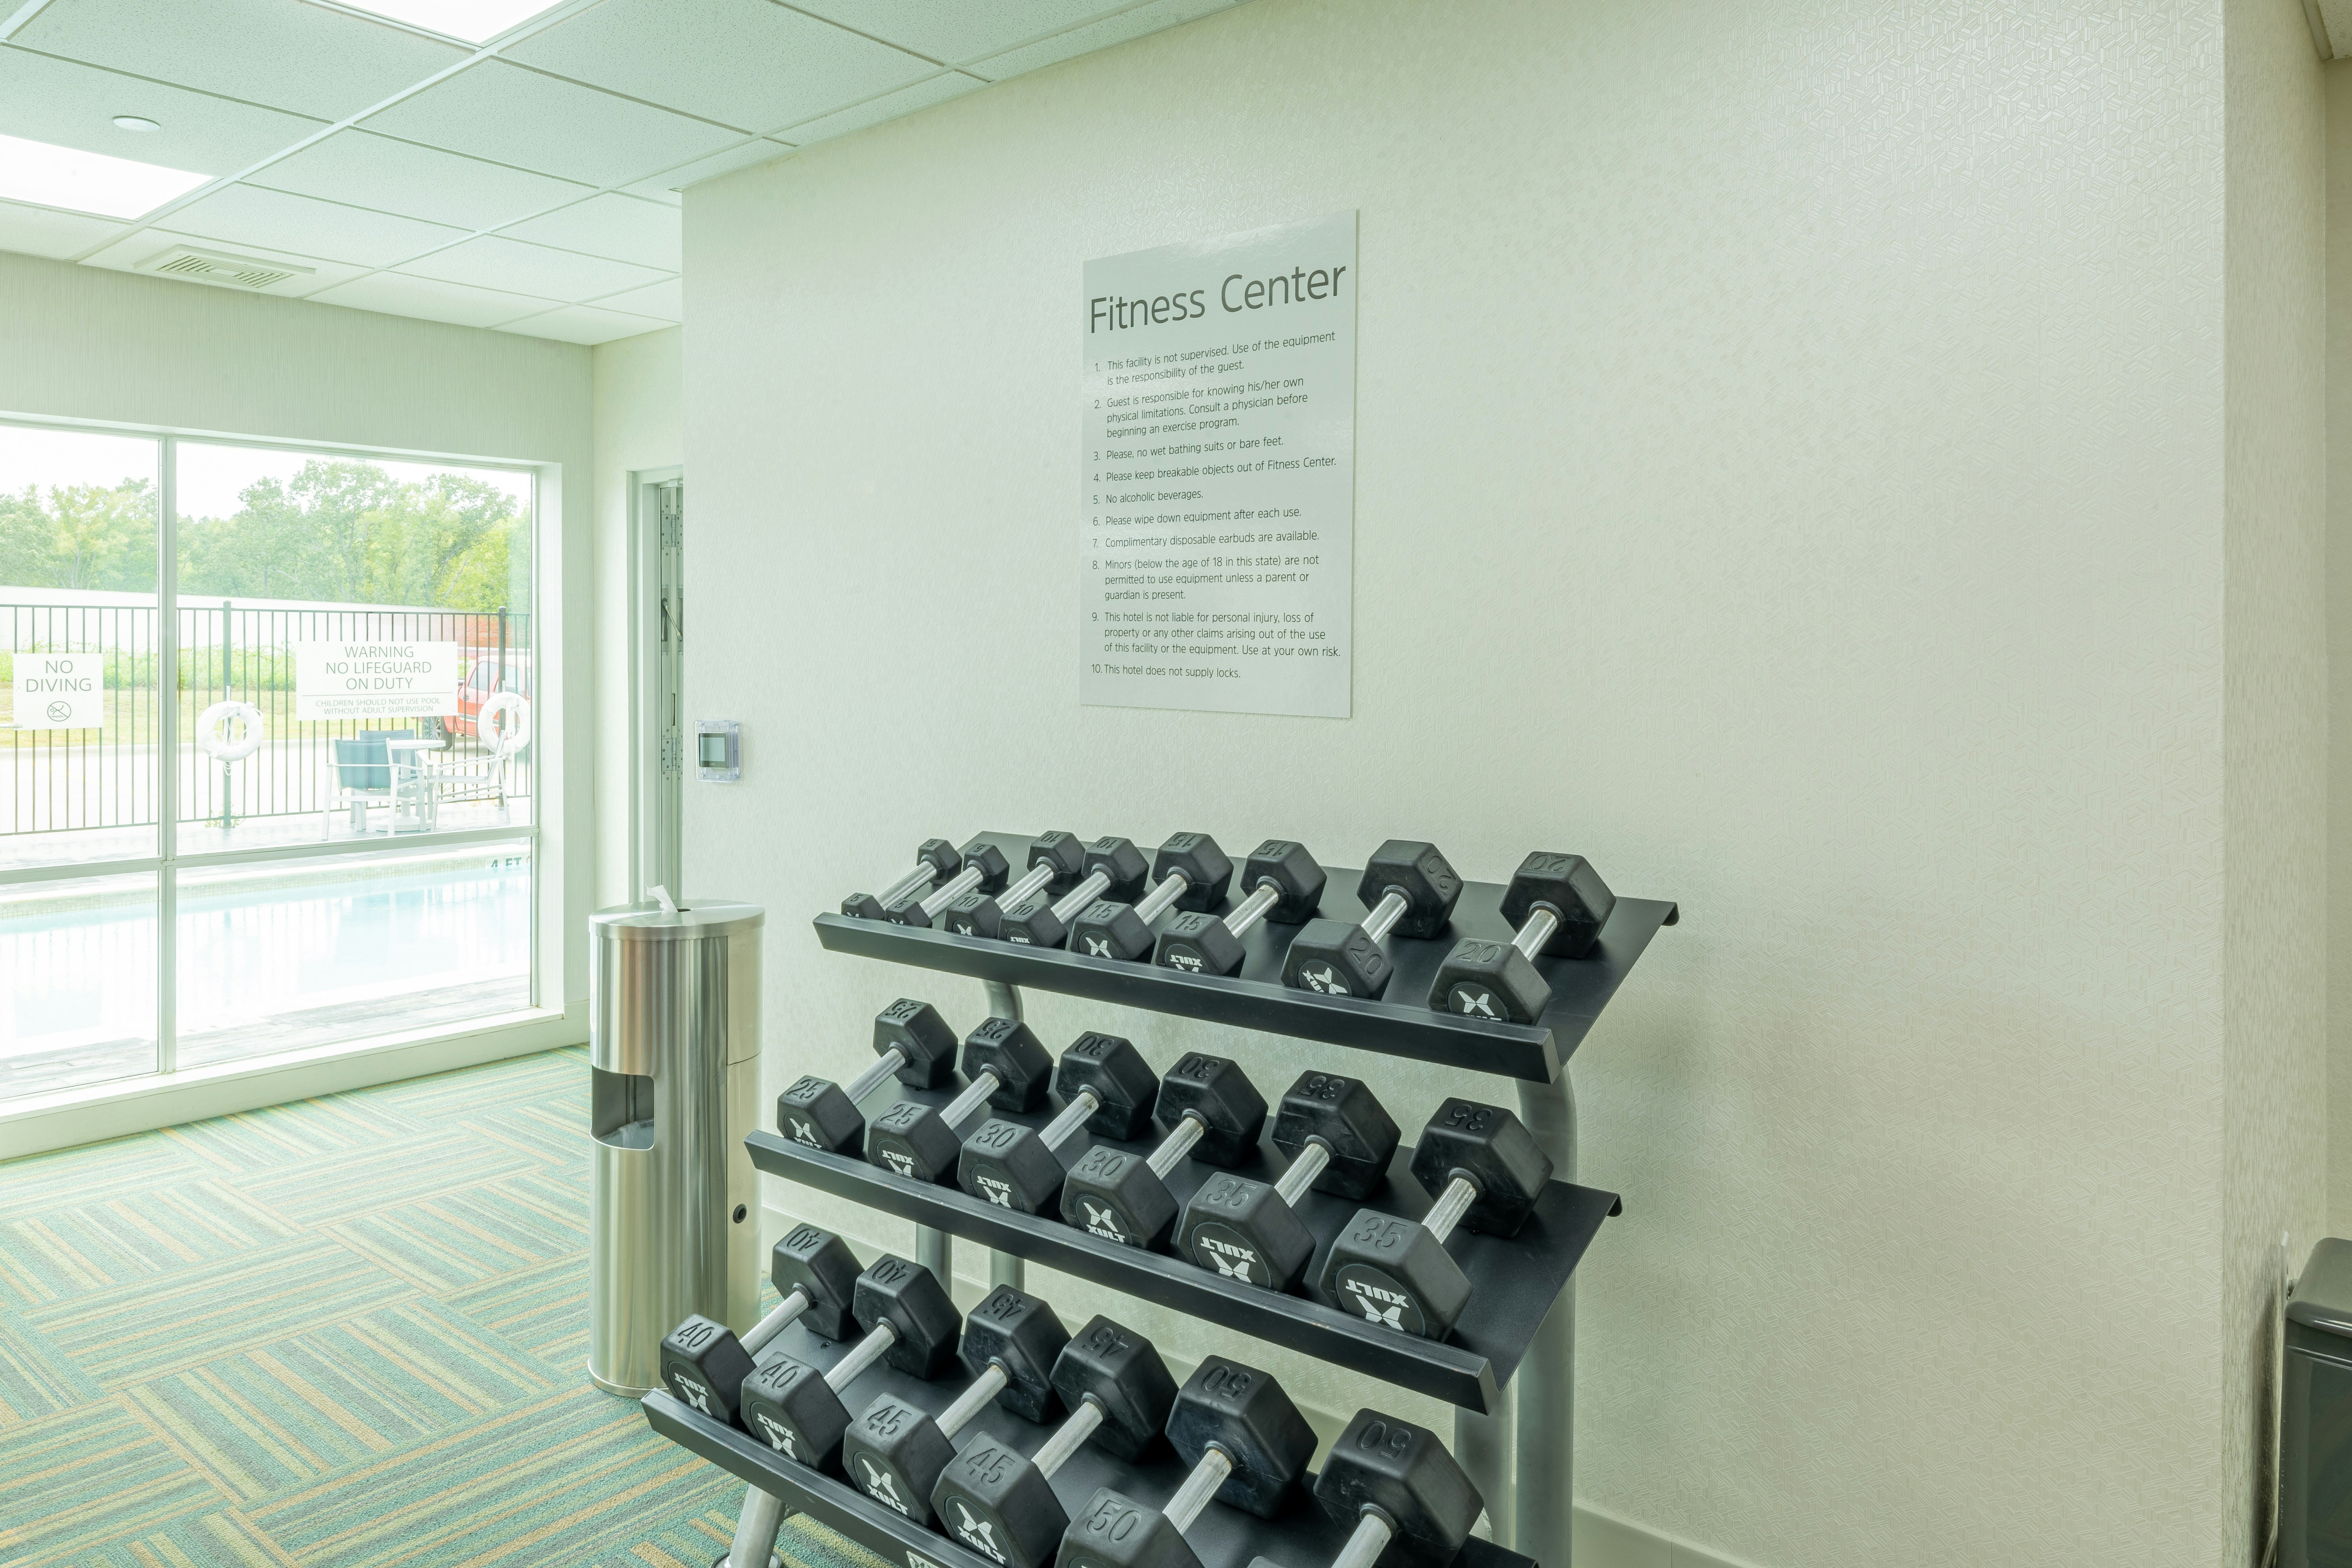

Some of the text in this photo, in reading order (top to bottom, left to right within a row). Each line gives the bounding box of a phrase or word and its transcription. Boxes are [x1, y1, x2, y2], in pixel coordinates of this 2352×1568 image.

[1091, 266, 1346, 334] Fitness Center
[1107, 331, 1336, 370] This facility not supervised. Use of the equipment
[1116, 360, 1244, 384] the responsibility of the guest.
[1107, 378, 1303, 408] Guest responsible for knowing his/her own
[1107, 393, 1308, 424] physical limitations. Consult physician before
[1107, 418, 1239, 438] beginning exercise program.
[1107, 436, 1283, 460] Please, no wet bathing suits bare feet.
[1106, 457, 1336, 482] Please keep breakable objects out Fitness Center.
[1106, 490, 1203, 504] No alcoholic beverages.
[1106, 507, 1302, 526] Please wipe down equipment after each use.
[1105, 530, 1319, 548] Complimentary disposable earbuds are available.
[1105, 555, 1319, 570] Minors (below the age 18 this state) are not
[1105, 574, 1144, 586] permitted
[1176, 573, 1223, 585] equipment
[1226, 572, 1254, 583] unless
[1265, 572, 1296, 583] parent
[1105, 590, 1186, 601] guardian present.
[1104, 612, 1301, 624] This hotel not liable for personal injury, loss
[1105, 628, 1326, 640] property any other claims arising out the use
[345, 646, 414, 657] WARNING
[1115, 643, 1341, 657] this facility the equipment. Use your own risk.
[46, 660, 73, 674] NO
[326, 661, 431, 674] NO LIFEGUARD
[1104, 664, 1241, 678] This hotel does not supply locks.
[26, 678, 91, 692] DIVING
[346, 677, 413, 690] ON DUTY
[850, 894, 863, 902] 5
[895, 900, 908, 909] 5
[958, 896, 978, 907] 10
[1012, 904, 1034, 915] 10
[1088, 903, 1119, 919] 15
[1174, 914, 1207, 931] 15
[1170, 954, 1203, 967] XULT
[1349, 937, 1384, 975] 20
[1456, 941, 1501, 963] 20
[786, 1079, 825, 1099] 25
[880, 1104, 922, 1125] 25
[976, 1124, 1017, 1147] 30
[882, 1150, 914, 1166] XULT
[1082, 1151, 1127, 1176] 30
[977, 1176, 1011, 1193] XULT
[1206, 1178, 1257, 1206] 35
[1086, 1224, 1125, 1243] XULT
[1354, 1217, 1409, 1249] 35
[1200, 1237, 1256, 1262] XULT
[1346, 1279, 1409, 1308] XULT
[677, 1323, 714, 1347] 40
[674, 1373, 706, 1395] XULT
[760, 1360, 798, 1388] 40
[757, 1413, 796, 1441] XULT
[867, 1406, 912, 1436] 45
[966, 1448, 1015, 1485] 45
[868, 1484, 908, 1515] XULT
[1087, 1499, 1141, 1543] 50
[958, 1525, 1006, 1564] XULT
